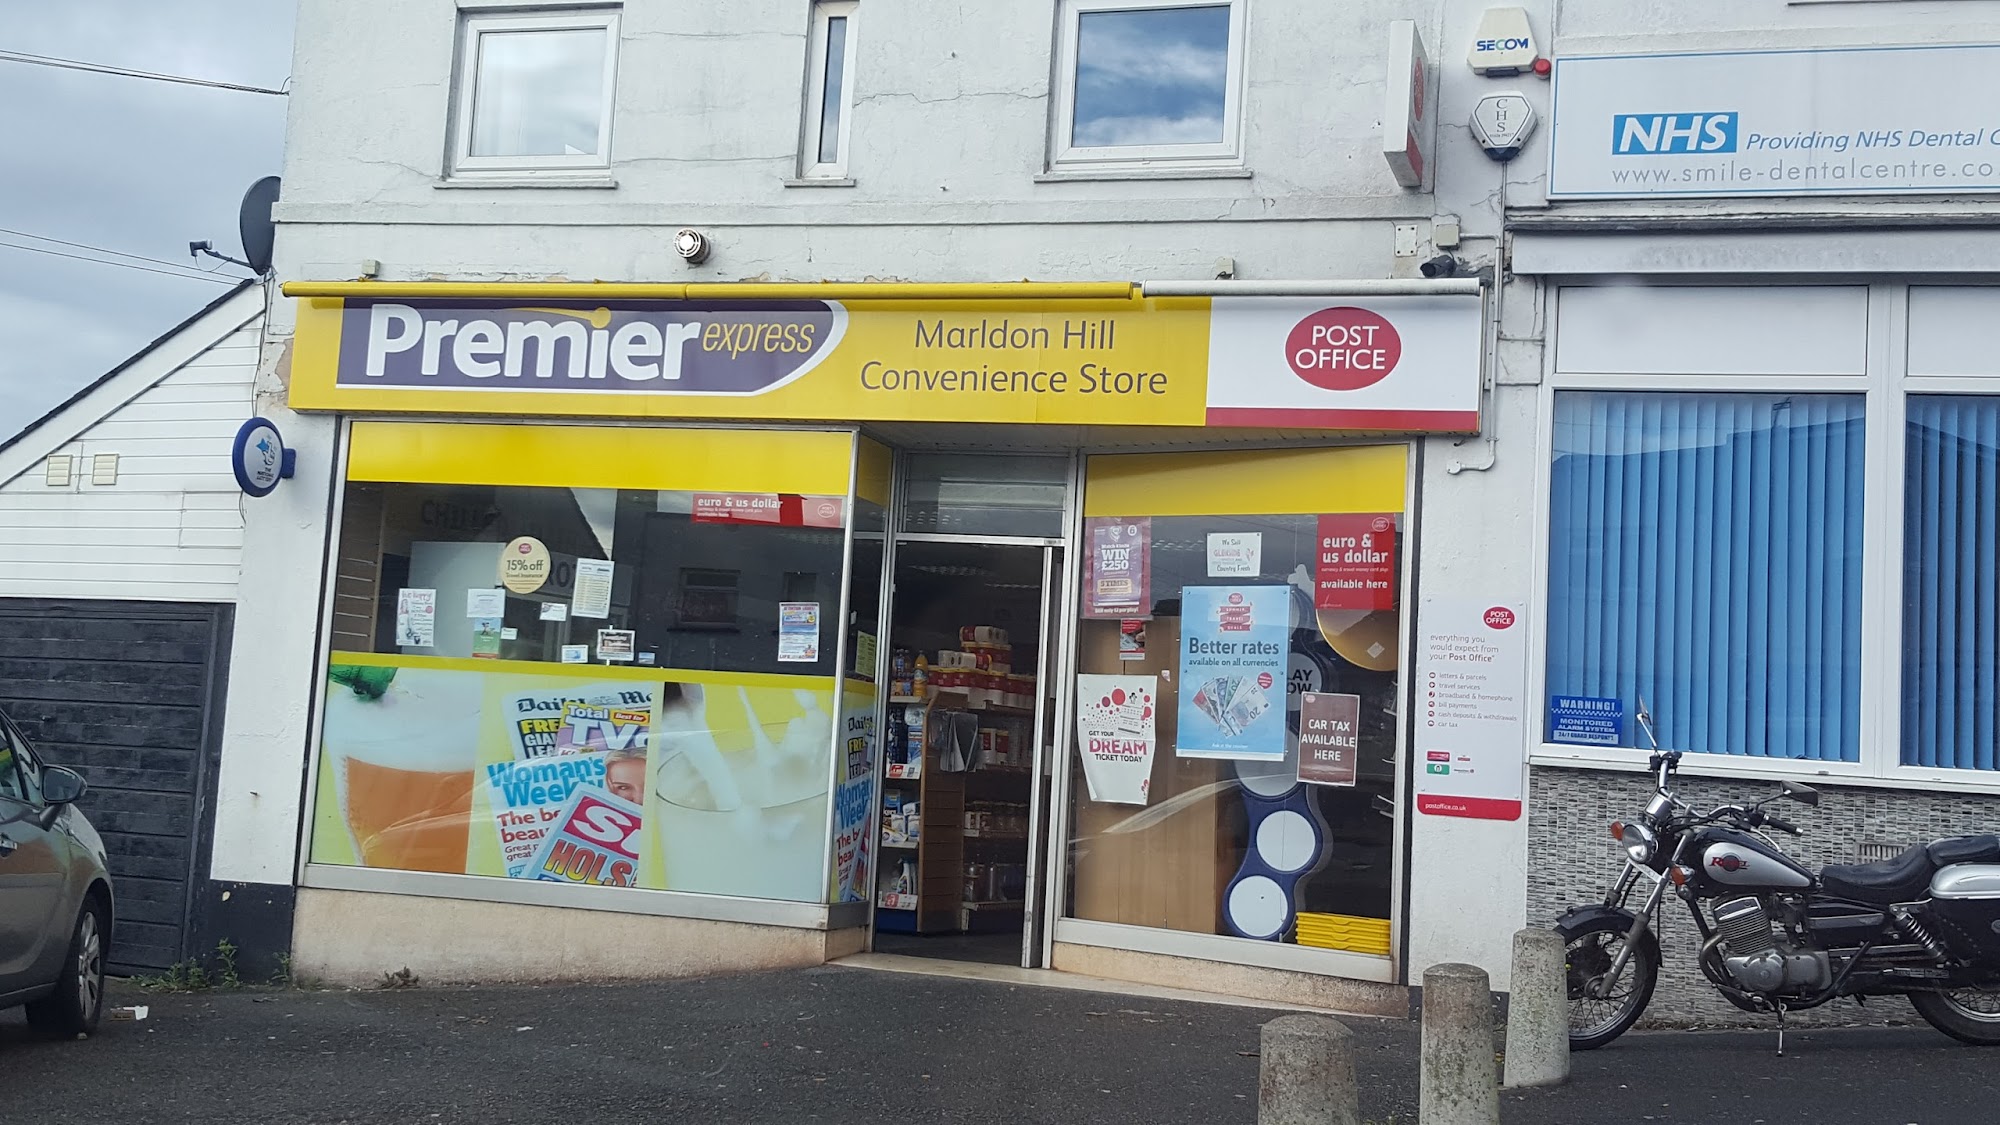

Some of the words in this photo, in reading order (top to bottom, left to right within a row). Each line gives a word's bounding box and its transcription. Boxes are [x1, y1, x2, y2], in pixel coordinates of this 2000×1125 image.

[1477, 38, 1529, 51] SECOM
[1619, 114, 1730, 152] NHS
[1747, 131, 1850, 153] Providing
[1856, 130, 1903, 148] NHS
[1908, 128, 1984, 147] Dental
[915, 319, 1049, 350] Marldon
[1063, 320, 1115, 350] Hill
[1312, 324, 1380, 346] POST
[366, 302, 701, 381] Premier
[703, 316, 816, 359] express
[1295, 348, 1386, 371] OFFICE
[860, 361, 1068, 393] Convenience
[1080, 363, 1169, 395] Store
[697, 498, 722, 507] euro
[725, 497, 733, 507] &
[736, 499, 748, 508] us
[751, 498, 784, 509] dollar
[1323, 536, 1356, 548] euro
[1361, 533, 1372, 548] &
[1101, 548, 1130, 560] WIN
[1322, 552, 1339, 563] us
[1344, 549, 1388, 563] dollar
[507, 559, 529, 571] 15%
[529, 559, 545, 571] off
[1101, 560, 1129, 571] £250
[1321, 579, 1363, 588] available
[1366, 579, 1388, 588] here
[1430, 634, 1469, 643] everything
[1189, 637, 1237, 655] Better
[1242, 641, 1280, 655] rates
[1454, 645, 1479, 653] expect
[1480, 645, 1499, 653] from
[1188, 657, 1219, 666] available
[1232, 658, 1241, 666] all
[1242, 658, 1279, 667] currencies
[1449, 653, 1466, 661] Post
[1466, 673, 1487, 681] parcels
[1478, 694, 1513, 702] homephone
[1559, 698, 1616, 711] WARNING!
[568, 705, 609, 719] Total
[1309, 719, 1327, 730] CAR
[1330, 720, 1351, 732] TAX
[1557, 724, 1584, 732] ALARM
[1560, 718, 1614, 727] MONITORED
[1089, 738, 1147, 755] DREAM
[1301, 733, 1355, 748] AVAILABLE
[1095, 754, 1119, 762] TICKET
[1120, 755, 1143, 763] TODAY
[1314, 750, 1341, 761] HERE
[487, 757, 607, 788] Woman's
[1425, 803, 1467, 811] postoffice.co.uk
[497, 810, 536, 827] The
[505, 843, 531, 854] Great
[506, 851, 533, 863] great
[543, 838, 634, 887] HOLS
